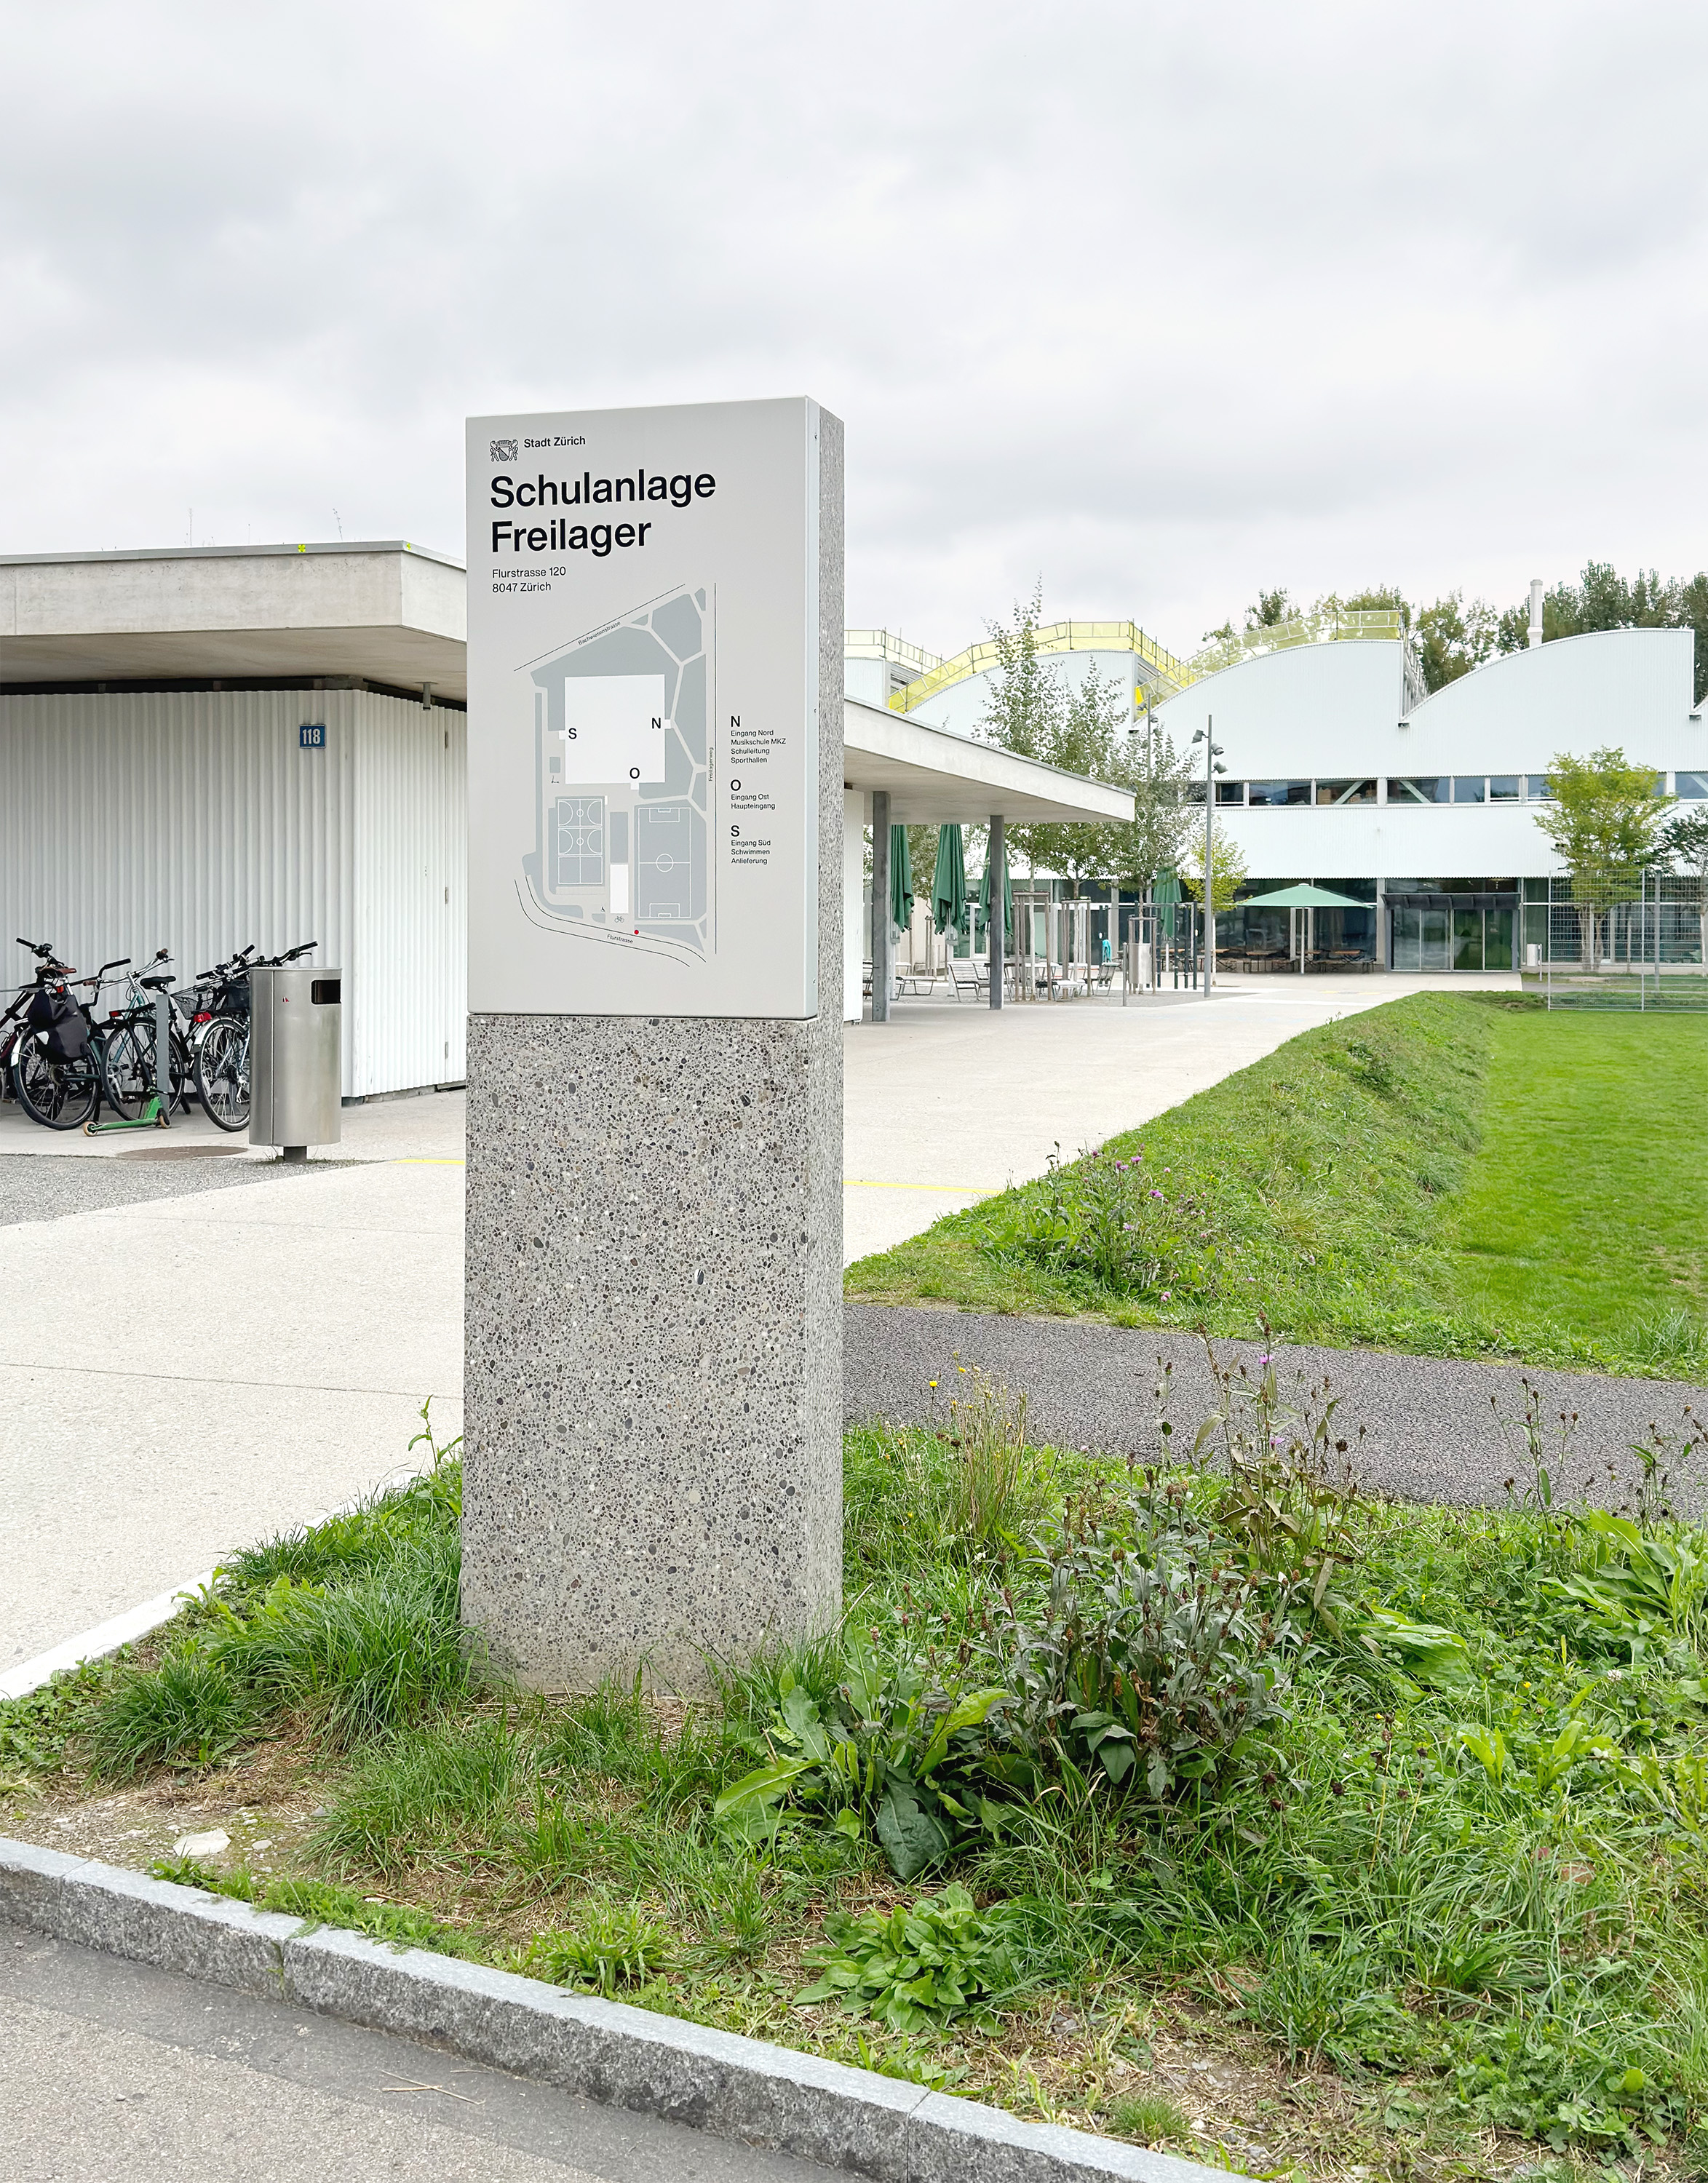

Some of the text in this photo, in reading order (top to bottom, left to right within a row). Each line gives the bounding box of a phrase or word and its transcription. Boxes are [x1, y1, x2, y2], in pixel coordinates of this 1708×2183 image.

[523, 435, 586, 448] Stadt Zürich
[490, 469, 716, 509] Schulanlage
[492, 518, 652, 557] Freilager
[492, 566, 566, 578] Flurstrasse 120
[492, 581, 552, 593] 8047 Zürich
[651, 717, 662, 729] N
[731, 715, 741, 728] N
[302, 728, 321, 744] 118
[568, 727, 577, 740] S
[731, 730, 757, 738] Eingang
[731, 757, 768, 765] Sporthallen
[629, 767, 640, 779] O
[730, 779, 742, 792] O
[731, 793, 757, 802] Eingang
[731, 803, 776, 811] Haupteingang
[730, 824, 740, 838] S
[731, 839, 757, 848] Eingang
[731, 857, 768, 866] Anlieferung
[607, 934, 633, 944] Flurstrasse
